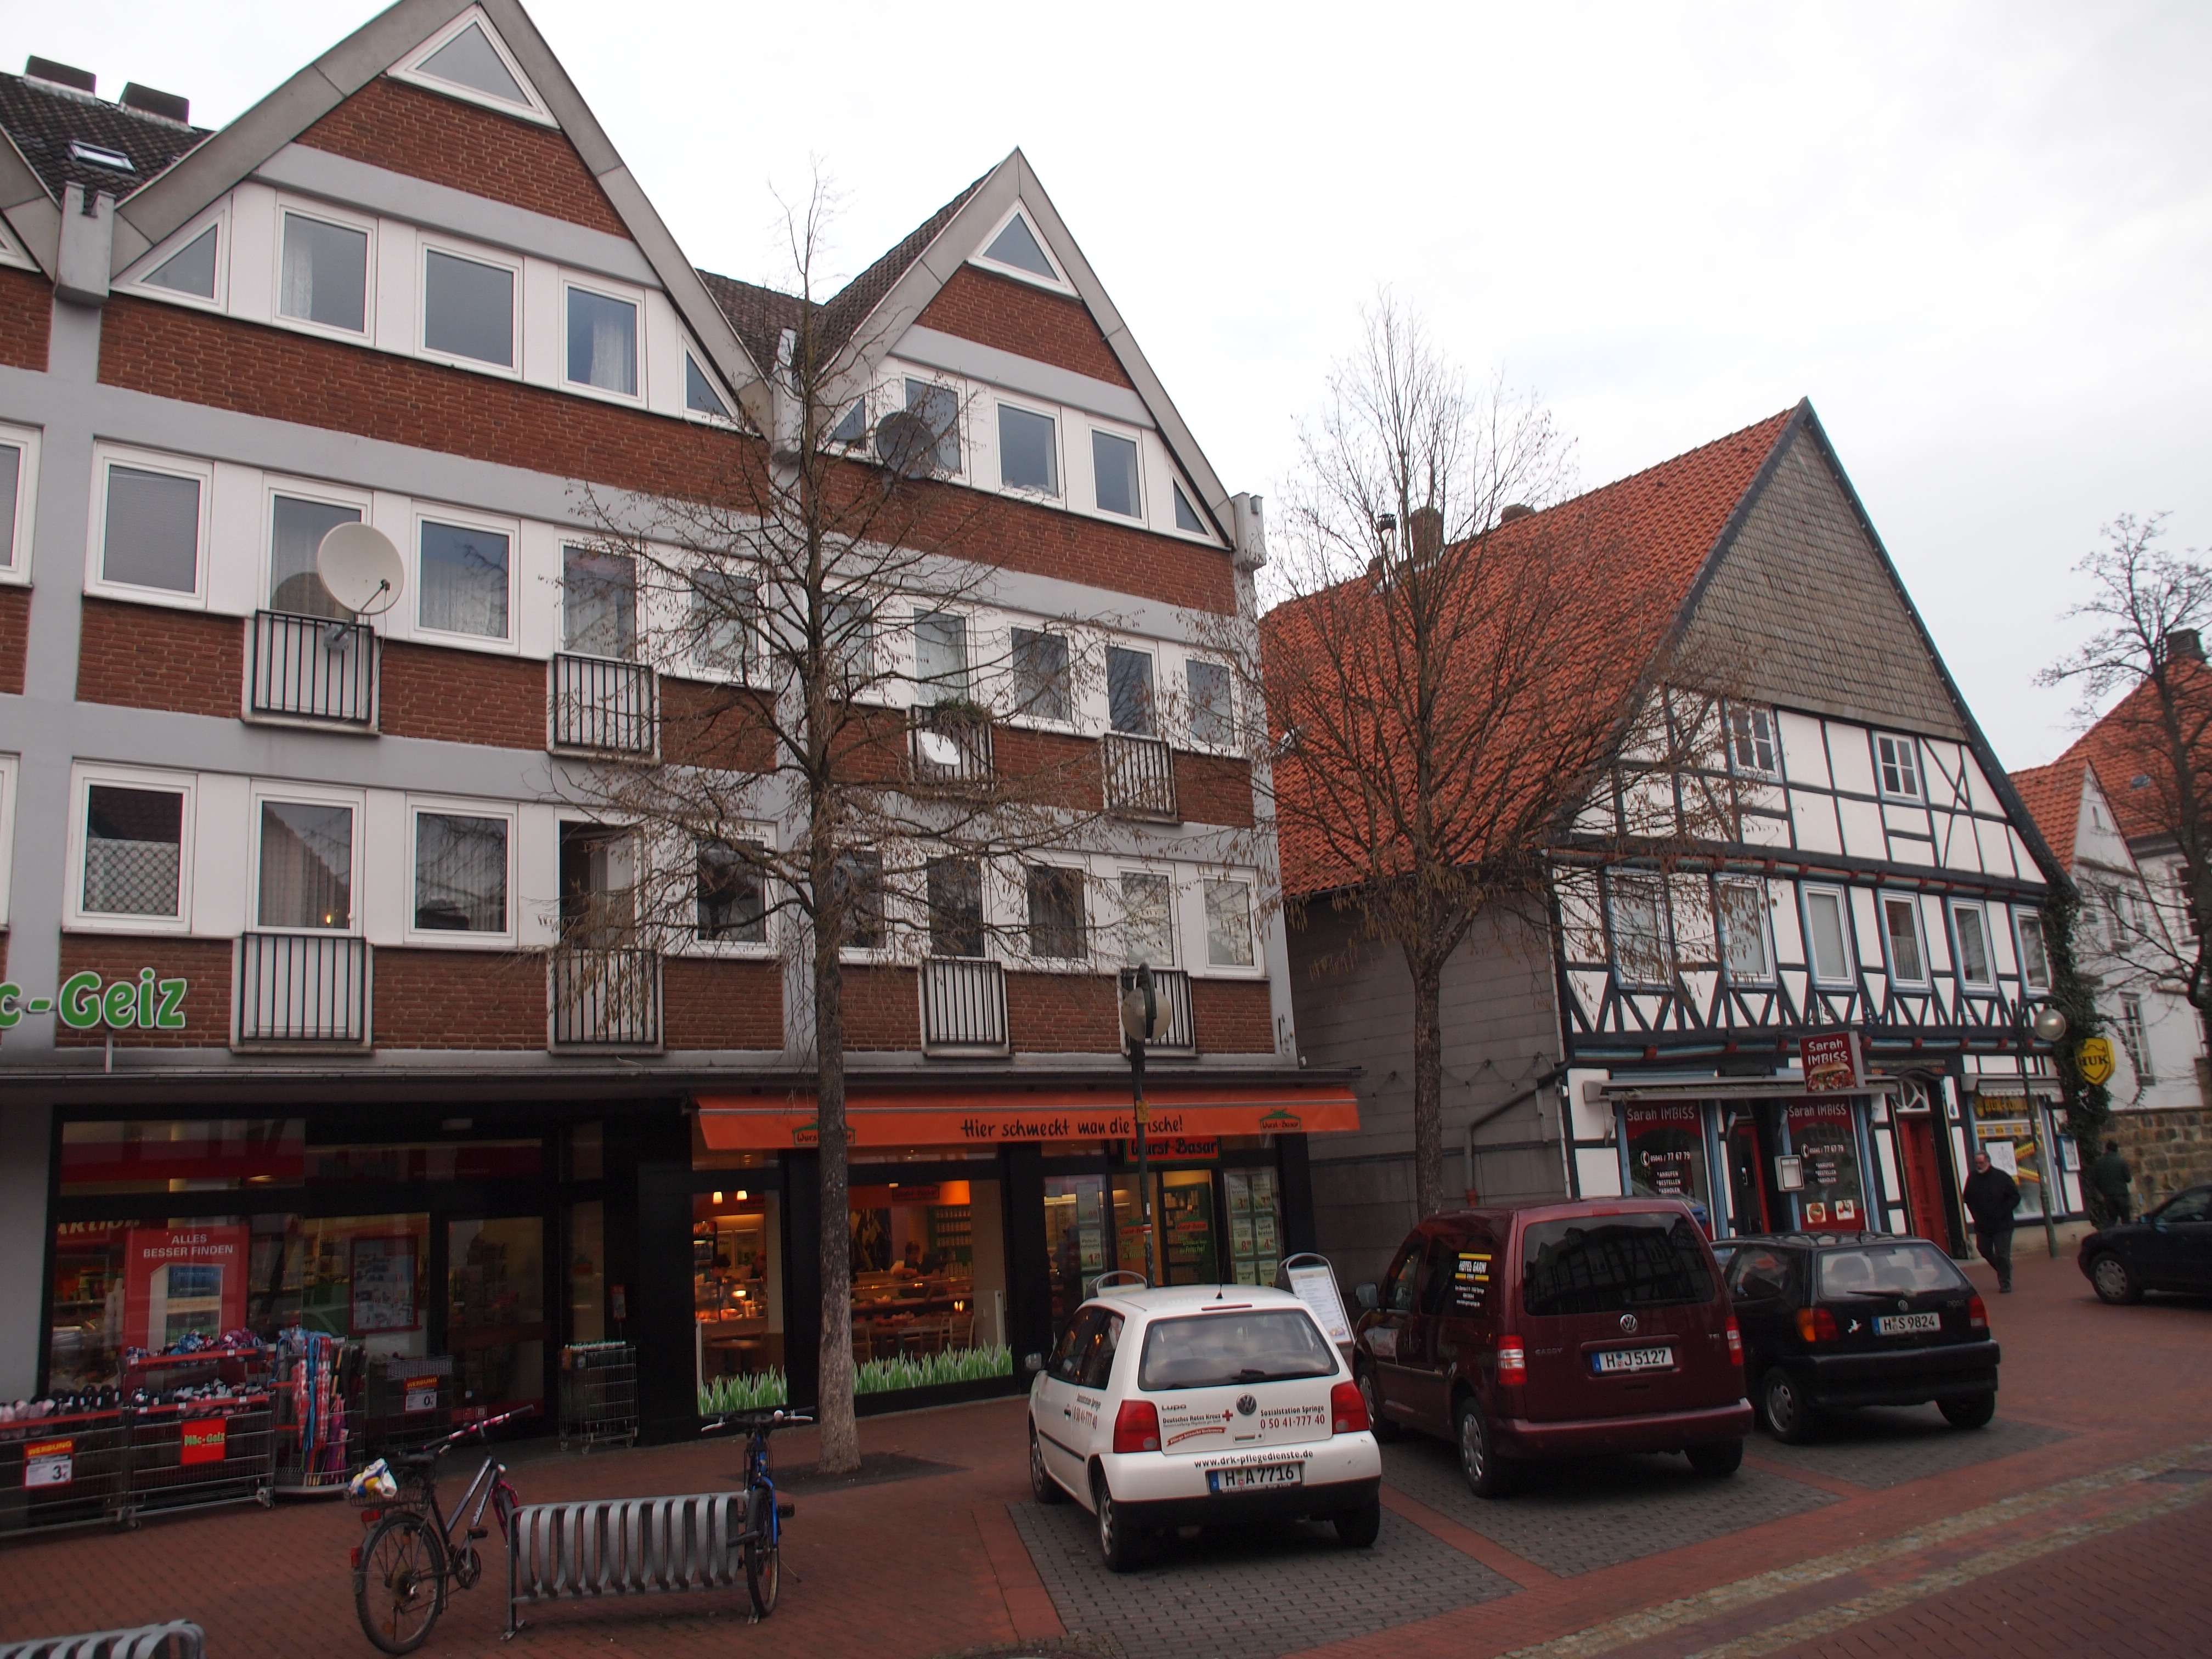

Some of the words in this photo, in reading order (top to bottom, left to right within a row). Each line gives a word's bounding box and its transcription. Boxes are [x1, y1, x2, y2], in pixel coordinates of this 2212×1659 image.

[1808, 1039, 1843, 1052] Sarah
[1808, 1051, 1848, 1065] IMBISS
[2078, 1056, 2108, 1065] HUK
[1627, 1108, 1657, 1122] Sarah
[1661, 1106, 1694, 1120] IMBISS
[1789, 1105, 1815, 1118] Sarah
[1818, 1103, 1847, 1116] IMBISS
[961, 1119, 996, 1137] Hier
[1002, 1116, 1069, 1136] schmeckt
[1078, 1124, 1105, 1135] man
[1110, 1116, 1129, 1134] die
[1133, 1114, 1183, 1133] ische!
[1262, 1120, 1299, 1129] Wurst-Basar
[1667, 1152, 1673, 1161] 77
[1675, 1152, 1682, 1160] 67
[1683, 1151, 1690, 1160] 79
[172, 1234, 207, 1245] ALLES
[143, 1246, 188, 1258] BESSER
[191, 1244, 233, 1255] FINDEN
[1459, 1260, 1472, 1272] HOTEL
[1472, 1261, 1487, 1274] GARNI
[1883, 1318, 1892, 1330] H
[1606, 1353, 1616, 1368] H
[407, 1377, 438, 1388] WERBUNG
[1261, 1407, 1300, 1416] Sozialstation
[1302, 1405, 1324, 1414] Springe
[1260, 1419, 1266, 1429] 0
[1269, 1418, 1279, 1429] 50
[1315, 1414, 1325, 1425] 40
[27, 1440, 72, 1455] WERBUNG
[1194, 1449, 1313, 1468] www.drk-pflegedienste.de
[1225, 1471, 1235, 1486] H
